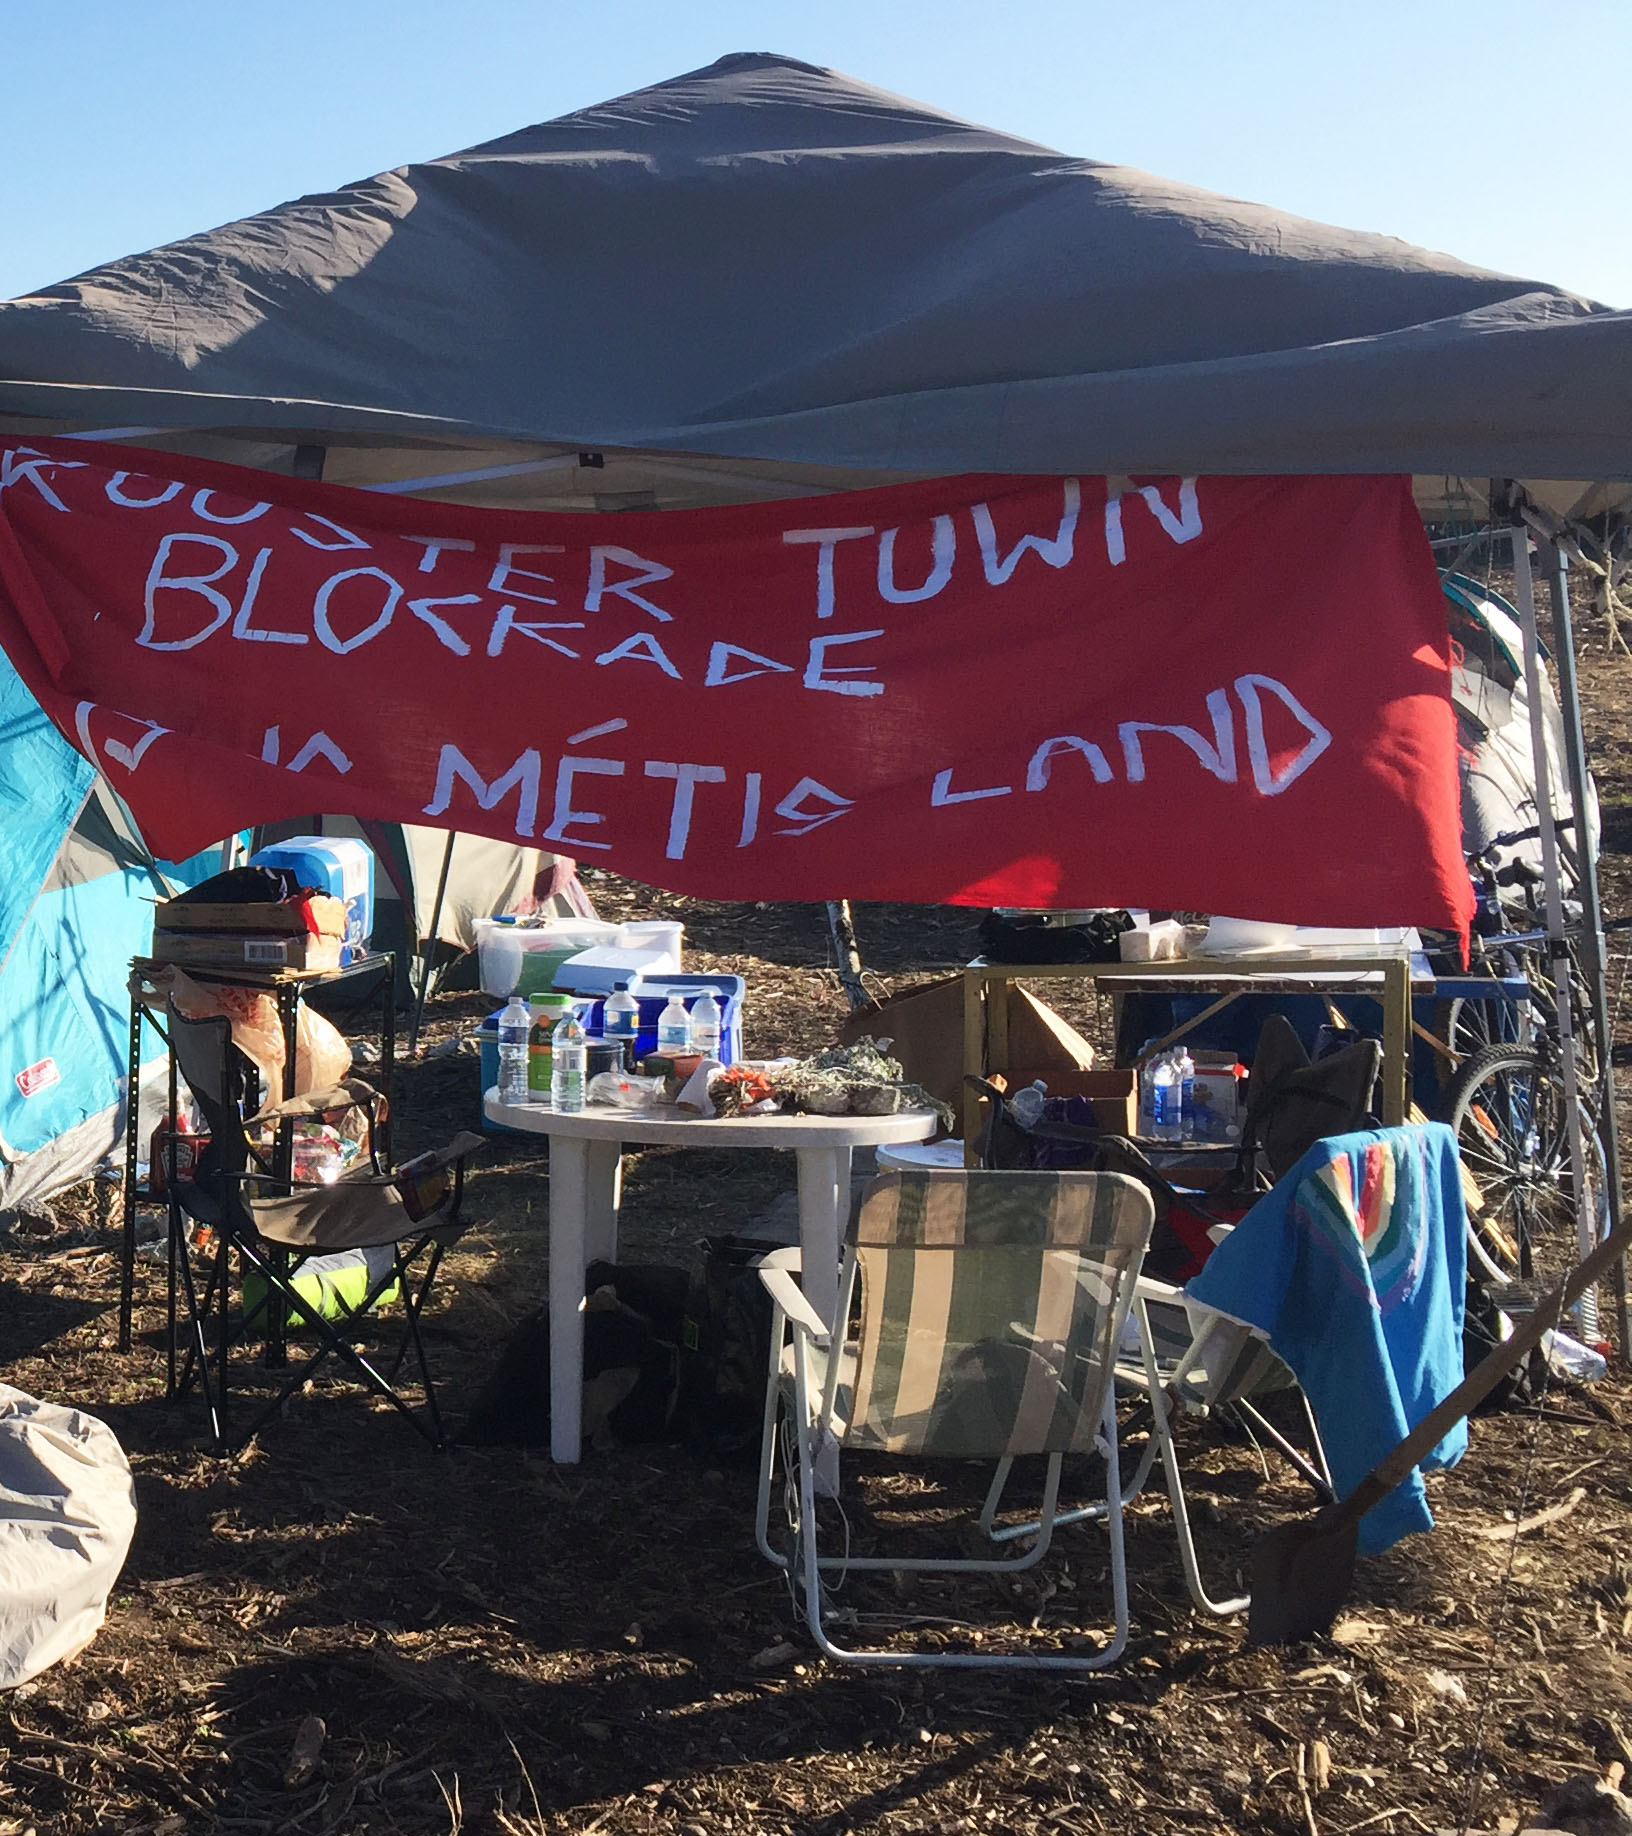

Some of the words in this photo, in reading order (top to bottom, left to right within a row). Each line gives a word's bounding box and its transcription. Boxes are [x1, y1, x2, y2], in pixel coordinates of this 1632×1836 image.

[135, 533, 884, 699] BLOCKADE
[422, 717, 856, 860] MÉTIS
[931, 673, 1332, 797] LAND
